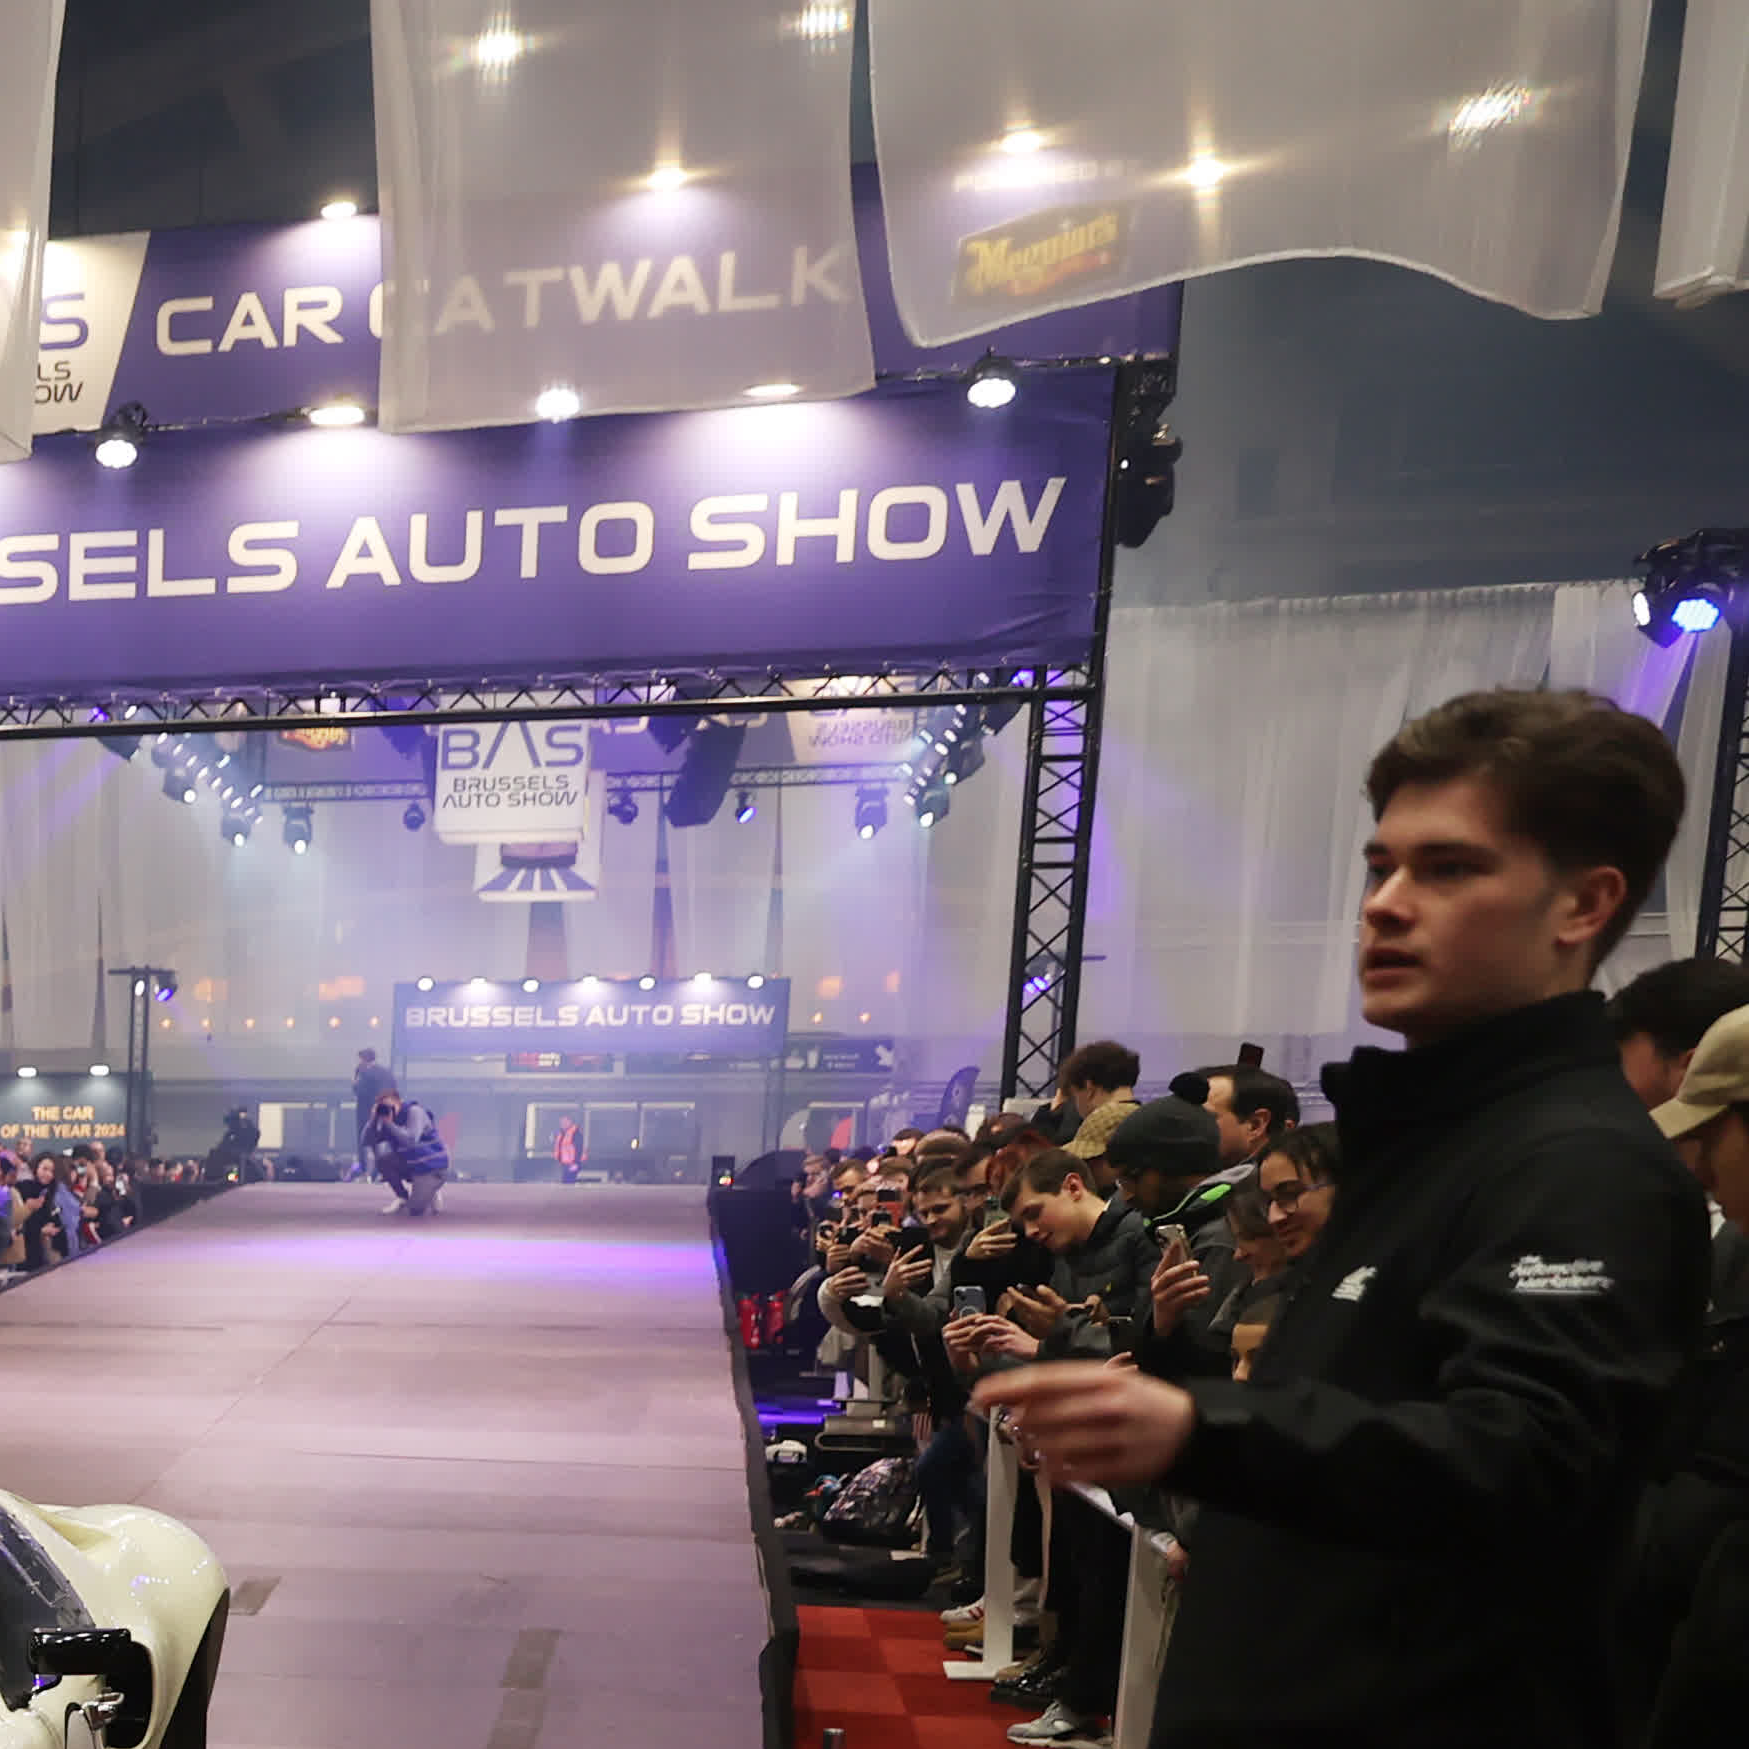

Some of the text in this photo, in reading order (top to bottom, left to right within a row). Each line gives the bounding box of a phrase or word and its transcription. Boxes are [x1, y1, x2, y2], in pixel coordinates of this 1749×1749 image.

[155, 286, 344, 356] CAR
[327, 500, 653, 590] AUTO
[686, 476, 1067, 572] SHOW
[440, 717, 585, 770] BAS
[453, 774, 570, 793] BRUSSELS
[442, 790, 578, 809] AUTO SHOW
[406, 1003, 775, 1027] BRUSSELS AUTO SHOW
[31, 1105, 95, 1120] THE CAR
[0, 1122, 126, 1138] OF THE YEAR 2024
